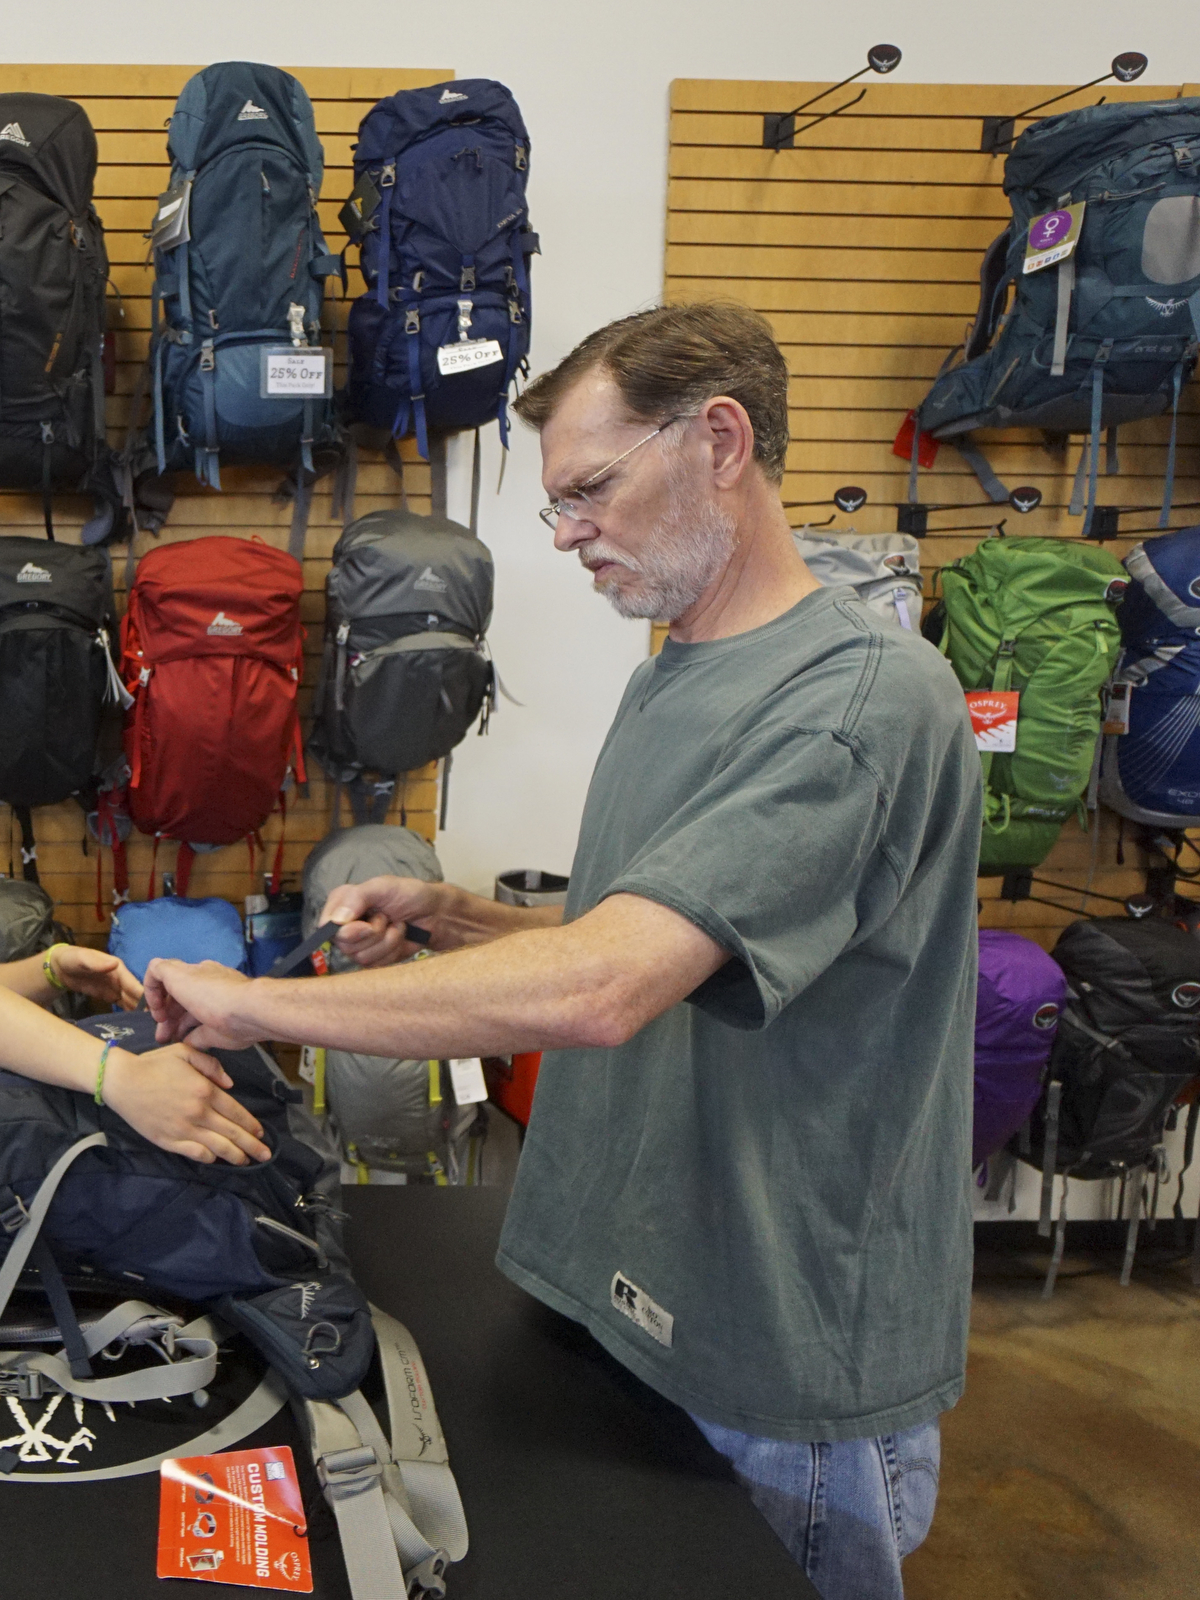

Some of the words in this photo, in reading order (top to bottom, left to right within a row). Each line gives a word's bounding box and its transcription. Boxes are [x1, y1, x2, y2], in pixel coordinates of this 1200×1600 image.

[442, 353, 472, 366] 25%
[270, 367, 298, 379] 25%
[16, 573, 52, 581] GREGORY
[969, 700, 1007, 709] OSPREY
[1167, 789, 1200, 798] EXO
[403, 1367, 422, 1420] ISOFORM
[247, 1463, 267, 1522] CUSTOM
[254, 1524, 270, 1578] MOLDING
[290, 1551, 302, 1581] OSPREY
